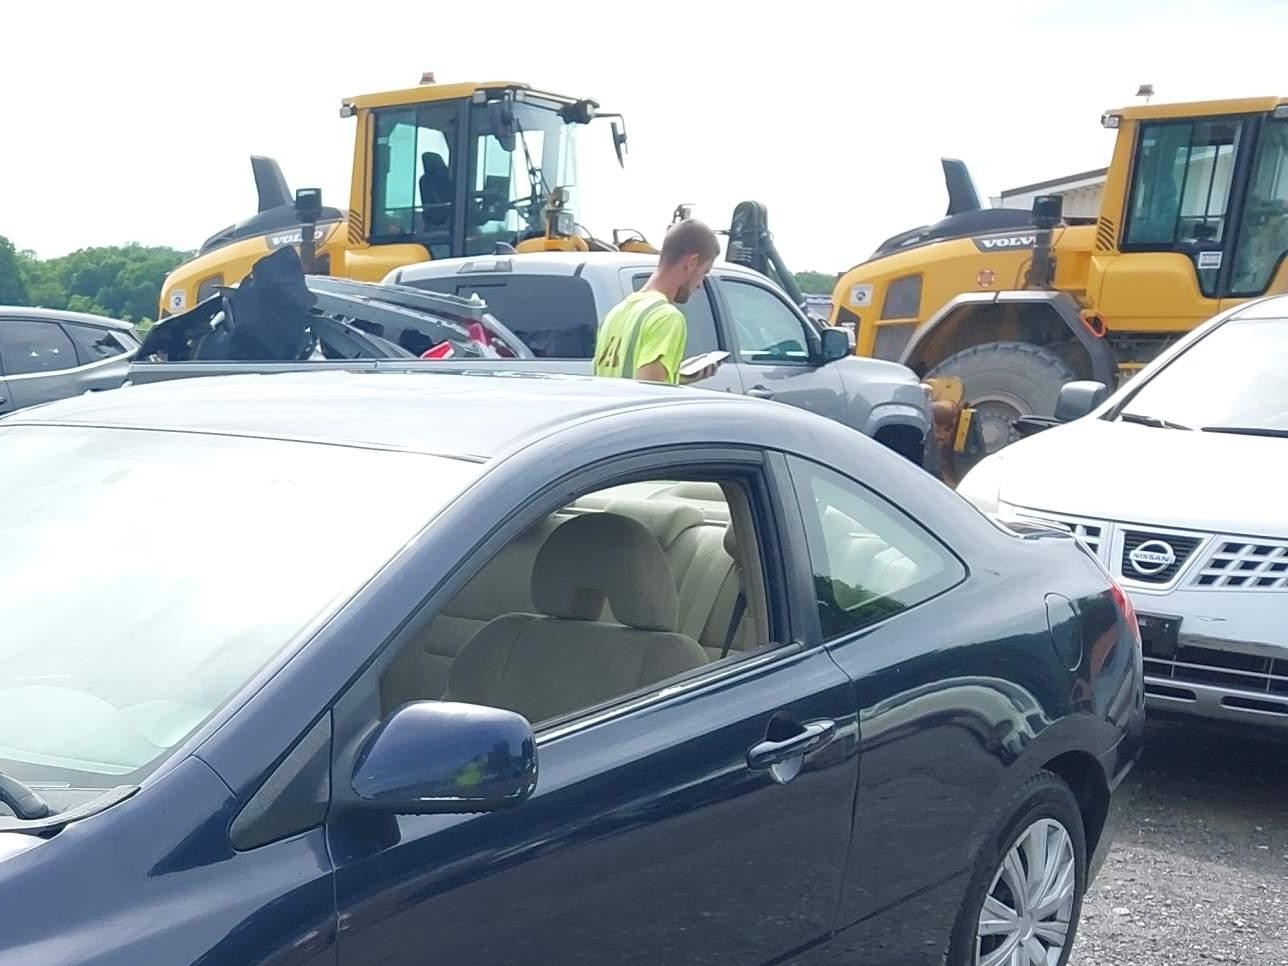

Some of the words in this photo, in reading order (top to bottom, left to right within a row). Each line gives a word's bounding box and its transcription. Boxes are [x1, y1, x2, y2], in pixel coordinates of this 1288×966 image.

[272, 230, 324, 246] VOLO
[981, 236, 1037, 248] VOLV
[1133, 552, 1170, 563] NISSAN
